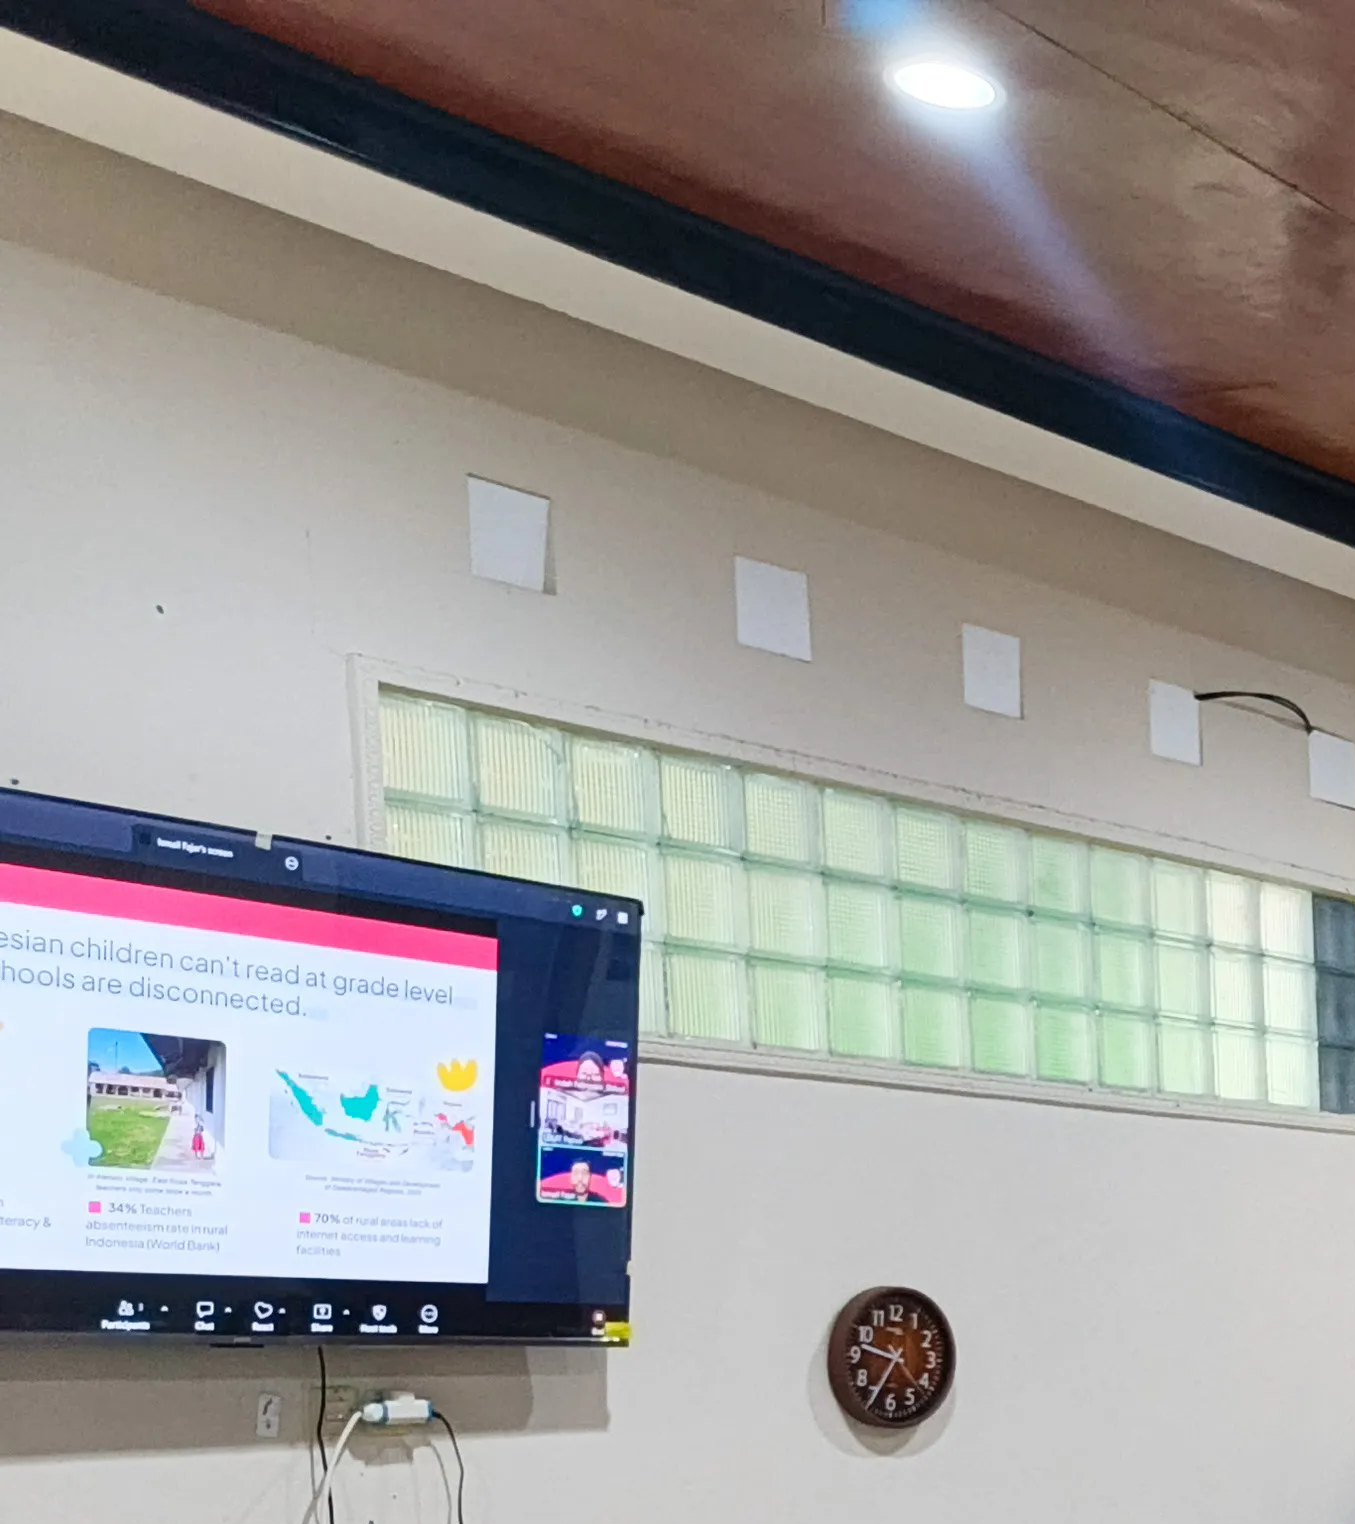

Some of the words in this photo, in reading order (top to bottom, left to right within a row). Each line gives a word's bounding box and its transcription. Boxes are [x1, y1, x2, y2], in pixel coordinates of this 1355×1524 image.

[70, 937, 173, 969] children
[180, 956, 240, 978] can't
[246, 963, 300, 985] read
[306, 970, 327, 989] at
[333, 976, 399, 996] grade
[405, 979, 453, 1005] level
[82, 974, 122, 995] are
[129, 976, 307, 1017] disconnected.
[108, 1202, 137, 1215] 34%
[139, 1203, 193, 1218] Teachers
[42, 1217, 52, 1228] &
[85, 1219, 165, 1233] absenteeism
[166, 1223, 189, 1235] rate
[191, 1223, 202, 1235] in
[201, 1224, 229, 1236] rural
[314, 1212, 341, 1224] 70%
[342, 1215, 355, 1225] of
[355, 1216, 379, 1226] rural
[380, 1219, 408, 1228] areas
[409, 1218, 430, 1229] lack
[431, 1218, 443, 1230] of
[85, 1236, 145, 1250] Indonesia
[146, 1237, 186, 1251] (World
[187, 1239, 221, 1252] Bank)
[296, 1229, 339, 1241] internet
[340, 1233, 378, 1243] access
[379, 1233, 400, 1243] and
[400, 1234, 442, 1247] learning
[872, 1310, 884, 1326] 11
[890, 1305, 903, 1321] 12
[911, 1313, 918, 1329] 1
[859, 1326, 873, 1343] 10
[921, 1331, 932, 1347] 2
[850, 1346, 861, 1363] 9
[925, 1352, 936, 1368] 3
[857, 1369, 867, 1386] 8
[919, 1373, 929, 1387] 4
[886, 1394, 896, 1410] 6
[905, 1388, 915, 1405] 5
